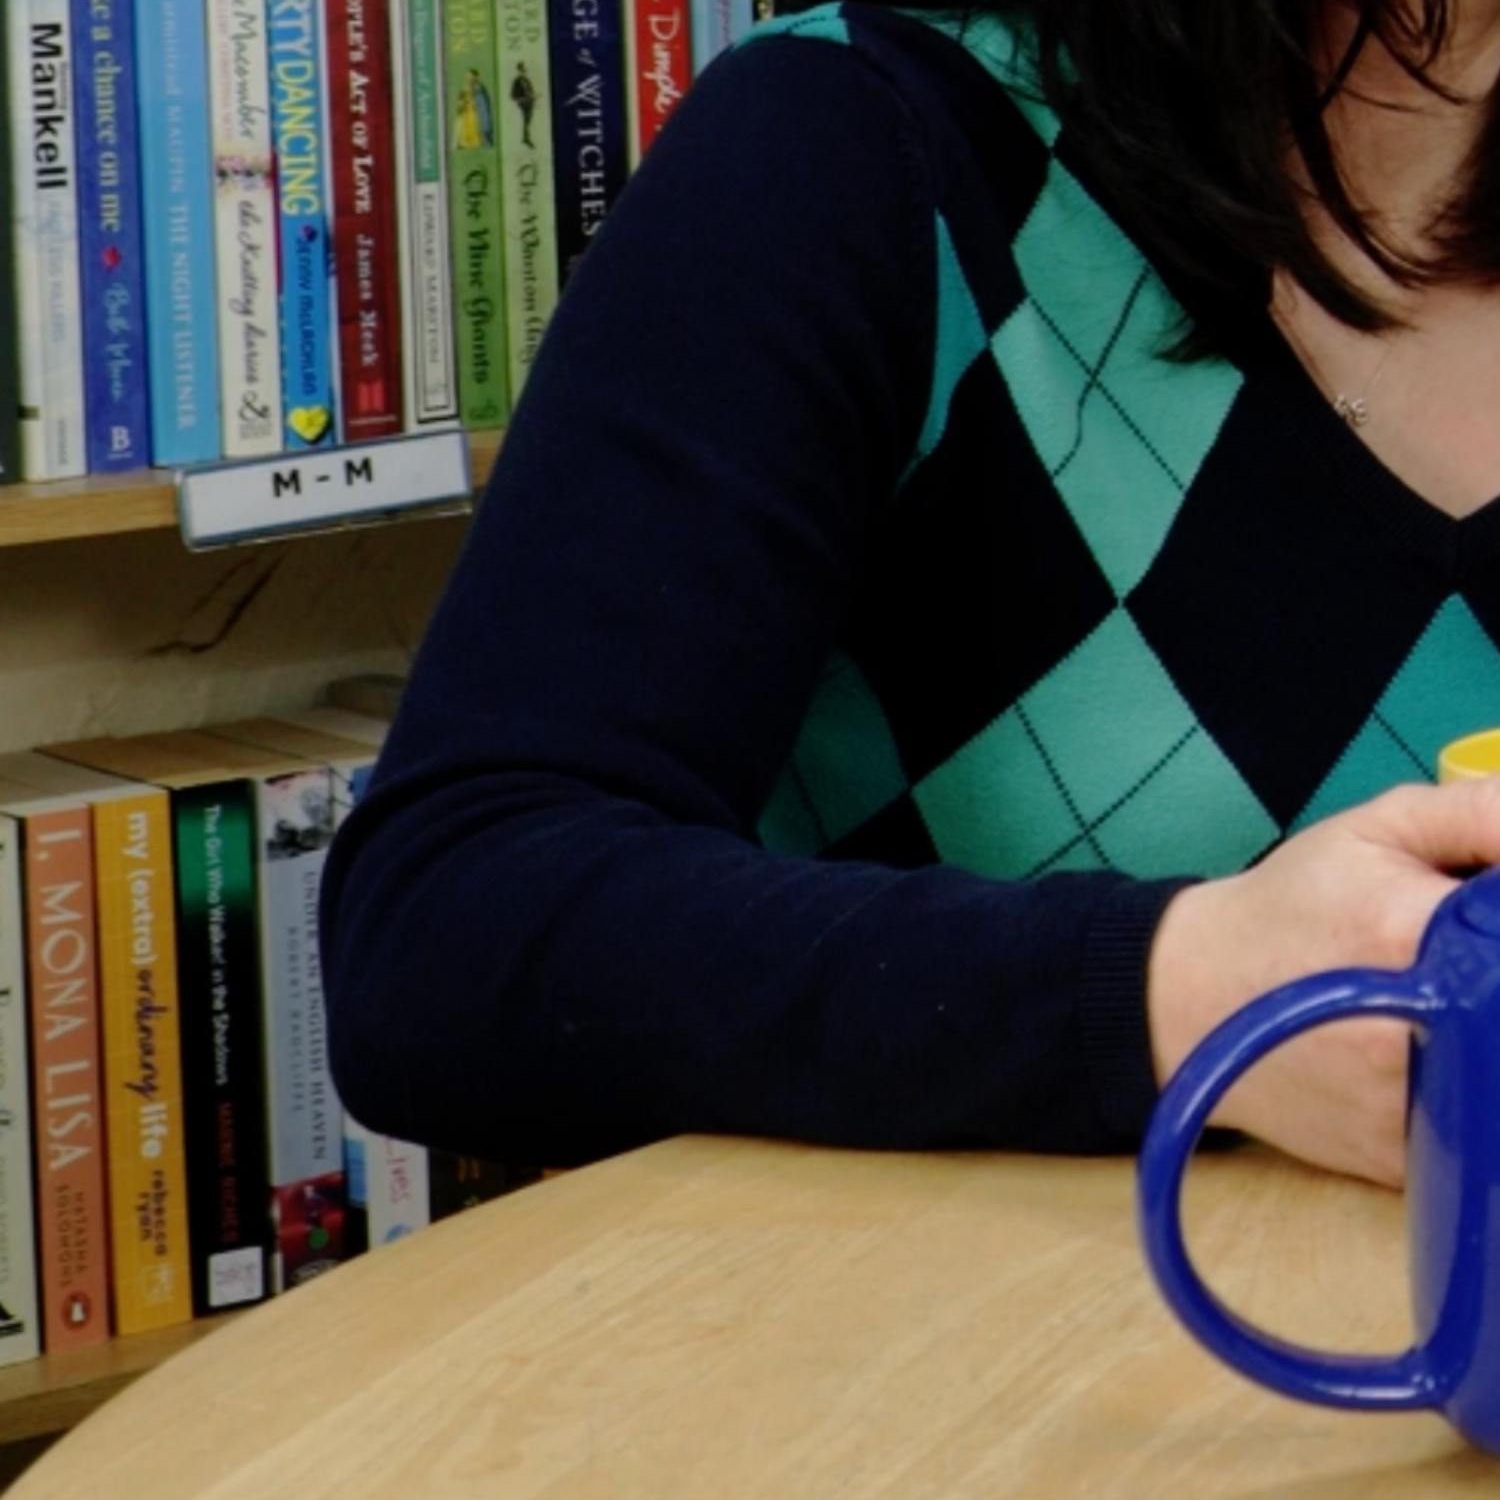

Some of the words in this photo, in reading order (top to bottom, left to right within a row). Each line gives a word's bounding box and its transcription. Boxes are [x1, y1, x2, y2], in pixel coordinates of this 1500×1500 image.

[92, 24, 113, 43] a
[642, 8, 685, 117] Dimple
[29, 21, 70, 191] Mankell
[92, 50, 124, 146] chance
[348, 71, 372, 116] ACT
[352, 122, 368, 148] OF
[97, 151, 121, 190] on
[353, 154, 376, 216] LOVE
[99, 192, 124, 235] me
[354, 233, 379, 301] James
[359, 308, 380, 368] Meek
[343, 457, 374, 486] M
[34, 827, 84, 863] I,
[126, 811, 154, 859] my
[129, 867, 158, 967] (extra)
[39, 878, 90, 1042] MONA
[123, 968, 169, 1102] ordinary
[43, 1058, 93, 1170] LISA
[138, 1103, 168, 1159] life
[137, 1191, 153, 1242] ryan
[149, 1169, 170, 1258] rebecca
